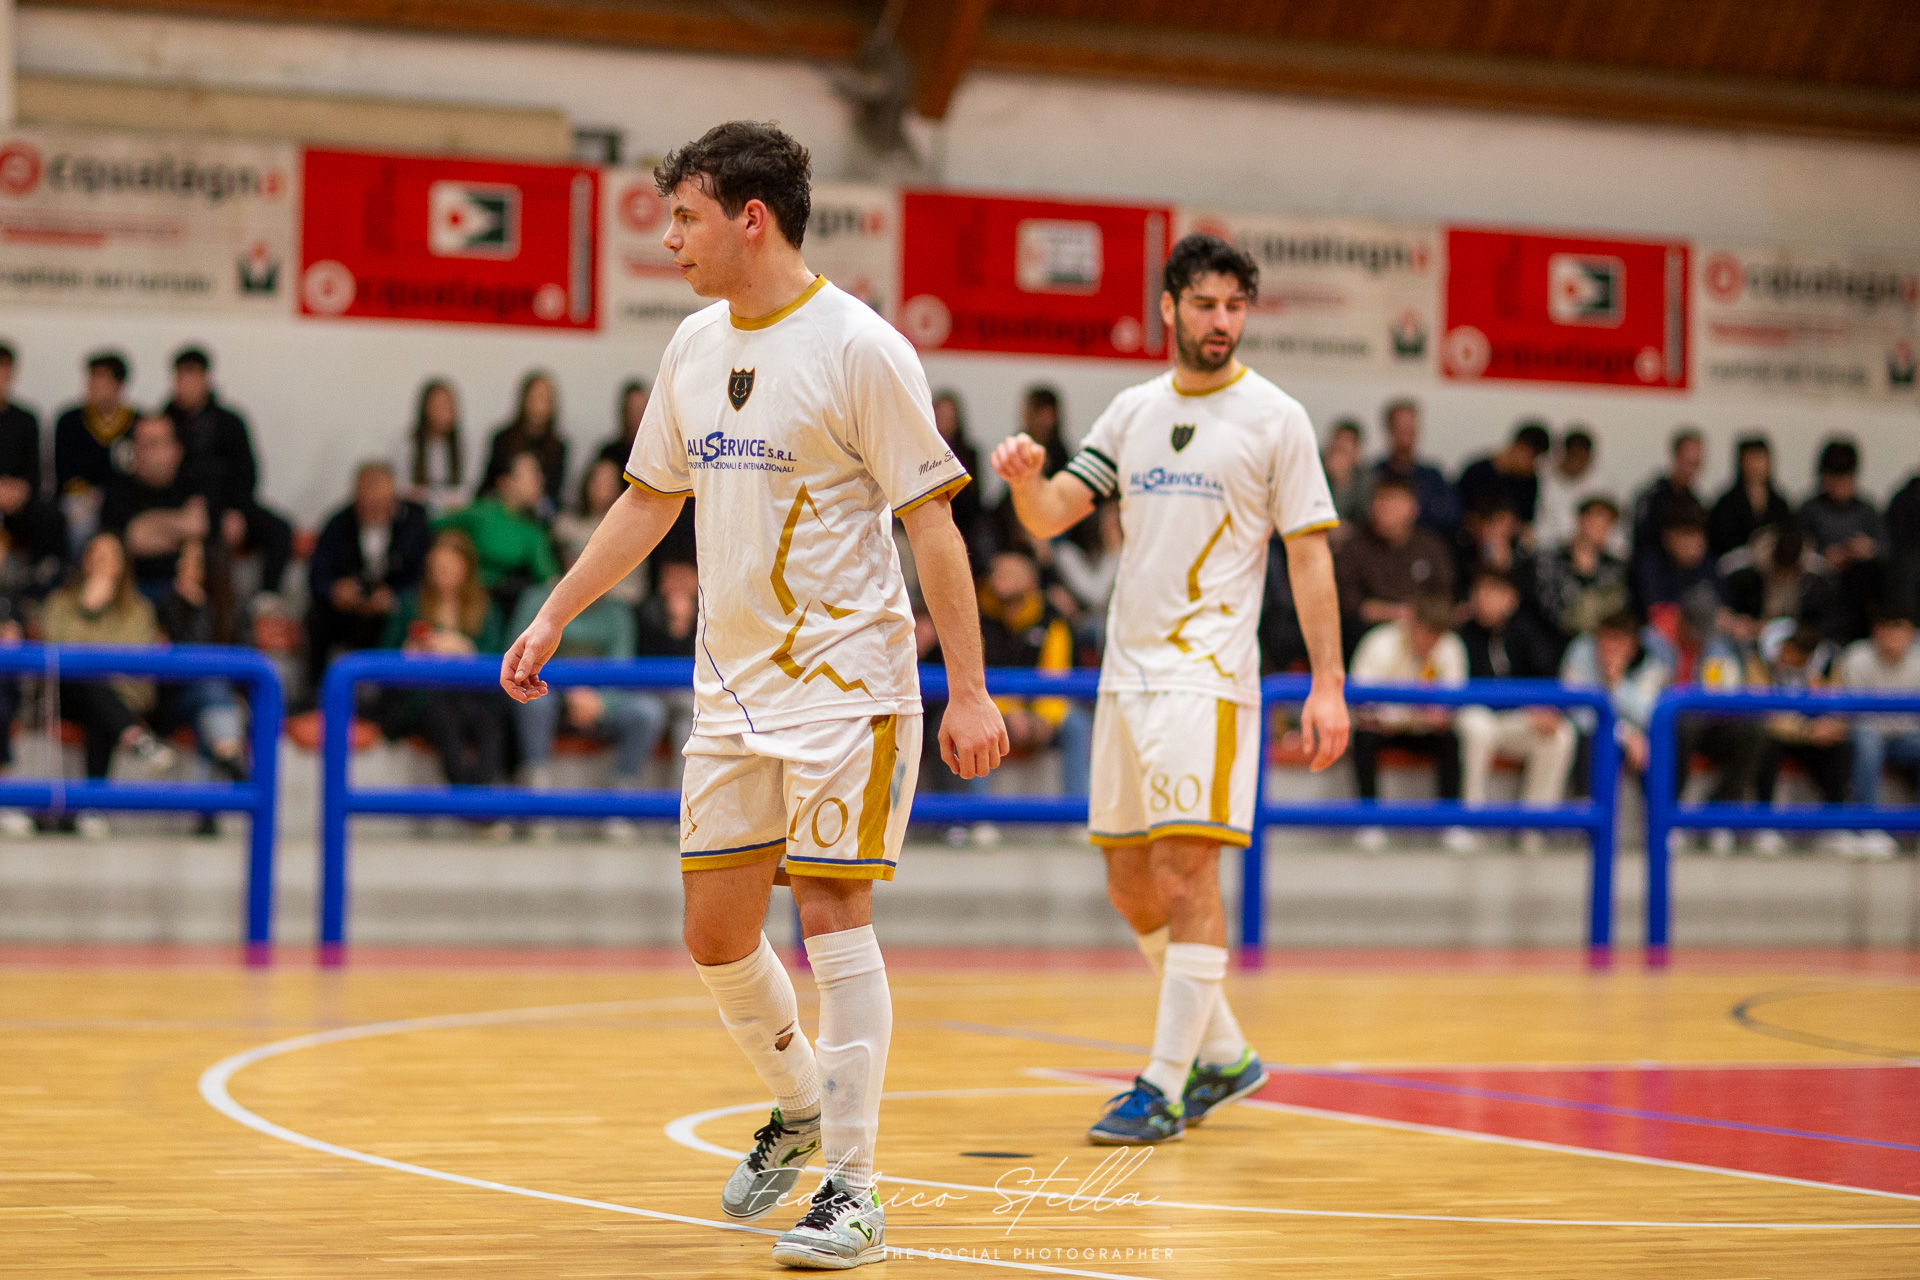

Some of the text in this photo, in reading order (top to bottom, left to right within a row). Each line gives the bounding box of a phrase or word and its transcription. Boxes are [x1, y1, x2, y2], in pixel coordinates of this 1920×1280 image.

[738, 461, 742, 470] E
[767, 448, 797, 462] S.R.L.
[1149, 773, 1201, 813] 80
[786, 796, 849, 848] 10
